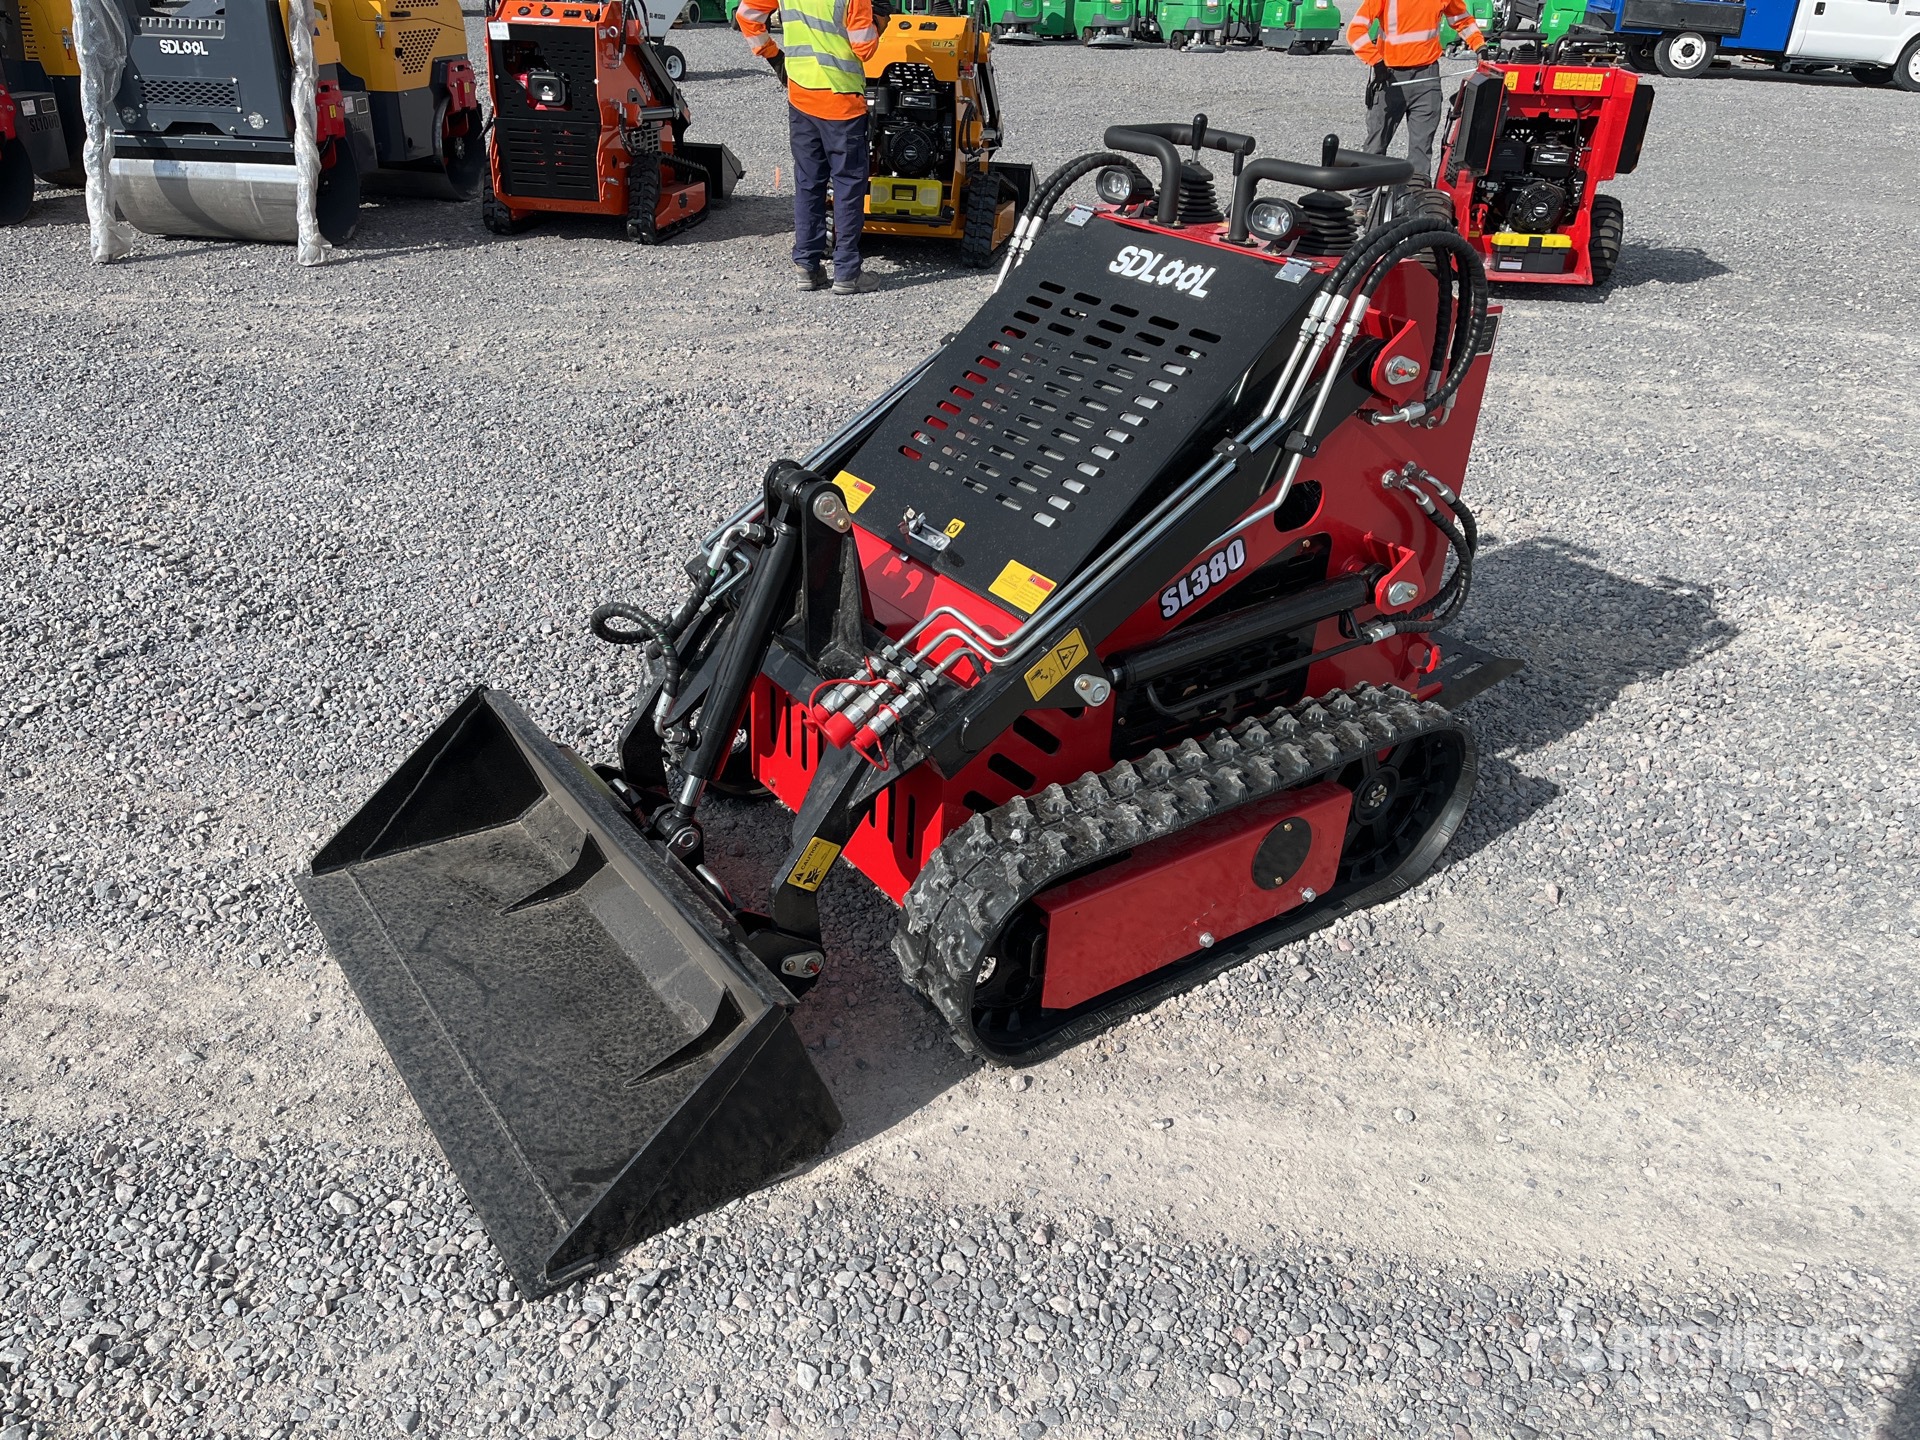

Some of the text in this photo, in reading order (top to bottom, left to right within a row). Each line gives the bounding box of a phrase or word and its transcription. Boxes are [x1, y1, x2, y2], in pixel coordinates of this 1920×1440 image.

[159, 39, 209, 55] SDLOOL
[1108, 245, 1217, 299] SDLOOL
[1161, 538, 1245, 618] SL380
[800, 841, 821, 871] CAUTION
